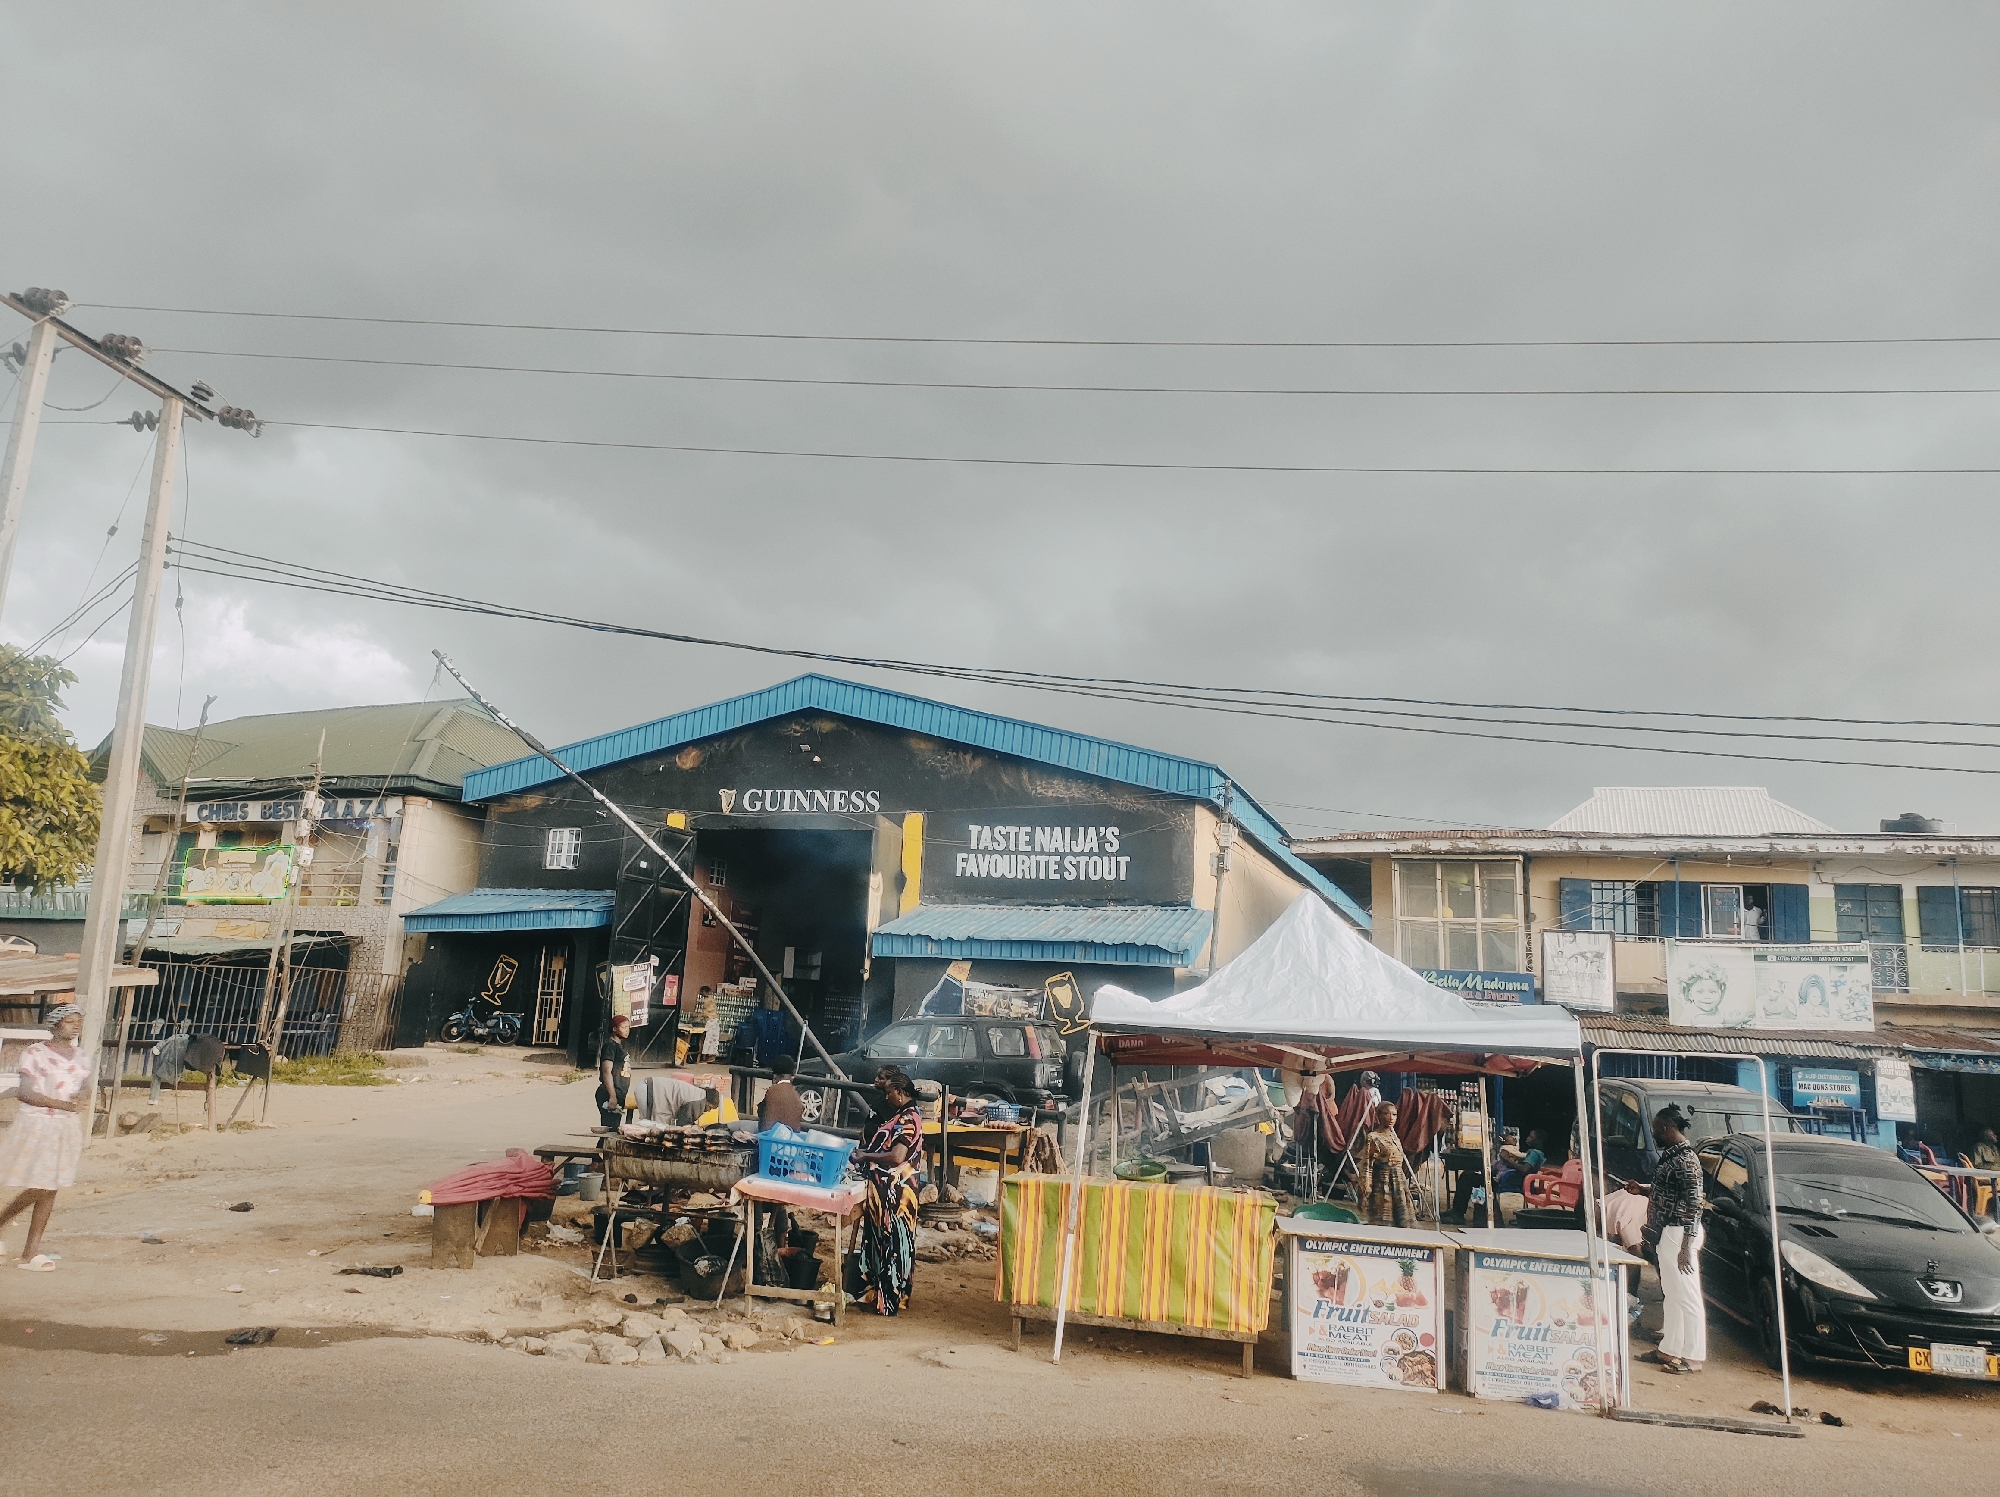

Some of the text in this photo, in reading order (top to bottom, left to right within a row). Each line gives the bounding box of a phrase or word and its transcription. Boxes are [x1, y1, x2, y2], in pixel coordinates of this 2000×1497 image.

[197, 799, 387, 821] CHRIS BEST PLAZA
[742, 789, 880, 813] GUINNESS
[969, 824, 1120, 853] TASTE NAIJA'S
[955, 852, 1131, 882] FAVOURITE STOUT
[1828, 944, 1867, 953] STUDIO
[1422, 971, 1460, 988] Bella
[1458, 973, 1530, 992] Madonna
[1306, 1239, 1430, 1259] OLYMPIC ENTERTAINMENT
[1483, 1257, 1526, 1271] OLYMPIC
[1313, 1300, 1420, 1328] Fruit SALAD
[1319, 1324, 1377, 1336] & RABBIT
[1328, 1332, 1372, 1342] MEAT
[1491, 1318, 1597, 1346] Fruit SALA
[1497, 1343, 1557, 1355] & RABBIT
[1508, 1350, 1552, 1361] MEAT
